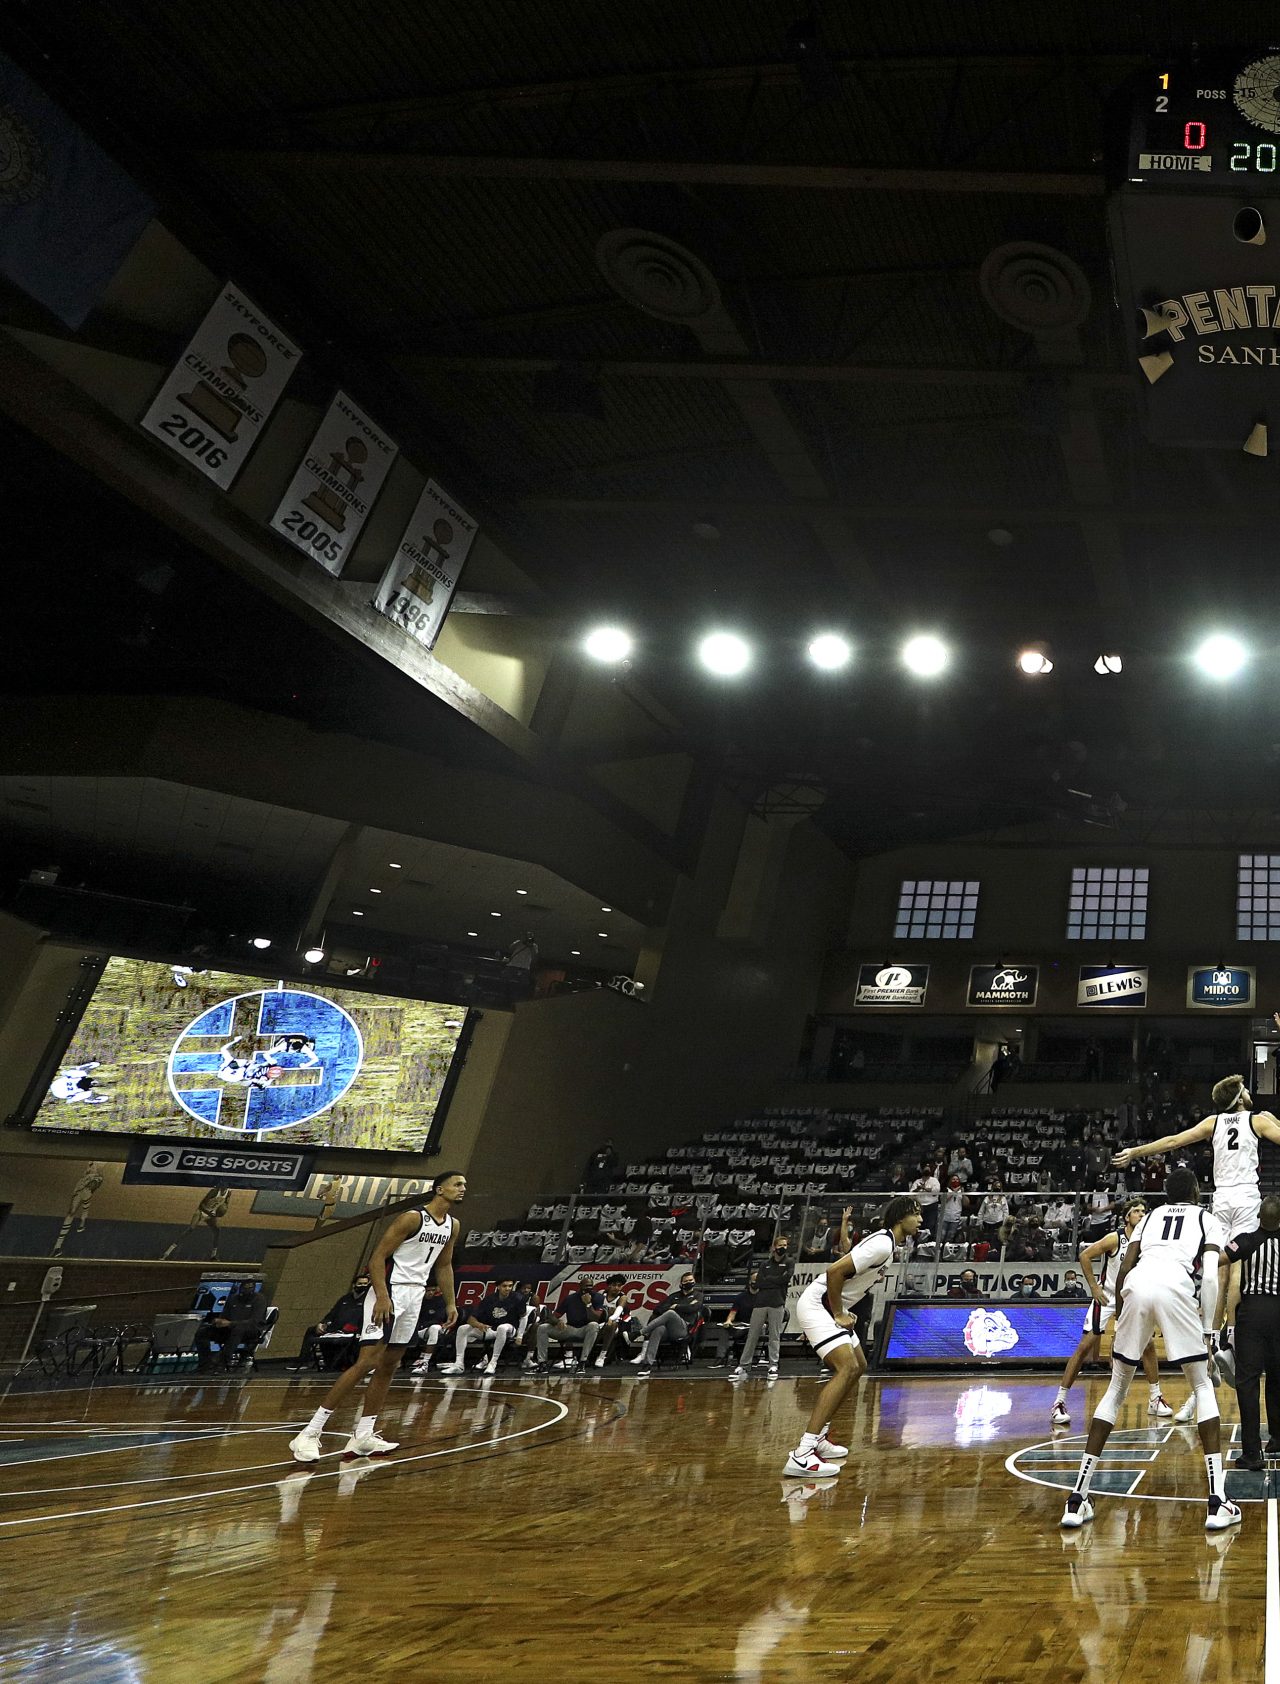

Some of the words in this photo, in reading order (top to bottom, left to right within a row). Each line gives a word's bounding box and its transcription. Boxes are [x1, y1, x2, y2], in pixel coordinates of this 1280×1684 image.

[1158, 73, 1169, 90] 1
[1196, 89, 1227, 99] POSS
[1241, 88, 1256, 99] 15
[1155, 96, 1169, 113] 2
[1184, 121, 1206, 149] 0
[1150, 155, 1201, 170] HOME
[224, 293, 299, 360] SKYFORCE
[336, 401, 396, 454] SKYFORCE
[158, 413, 228, 469] 2016
[305, 457, 367, 514] CHAMPIONS
[281, 510, 343, 561] 2005
[401, 542, 454, 589] CHAMPIONS
[386, 590, 431, 631] 1996
[976, 991, 1029, 999] MAMMOTH
[1098, 977, 1142, 994] LEWIS
[1203, 985, 1240, 995] MIDCO
[1227, 1127, 1239, 1151] 2
[182, 1154, 218, 1169] CBS
[221, 1157, 294, 1173] SPORTS
[1161, 1215, 1185, 1241] 11
[424, 1246, 435, 1264] 1
